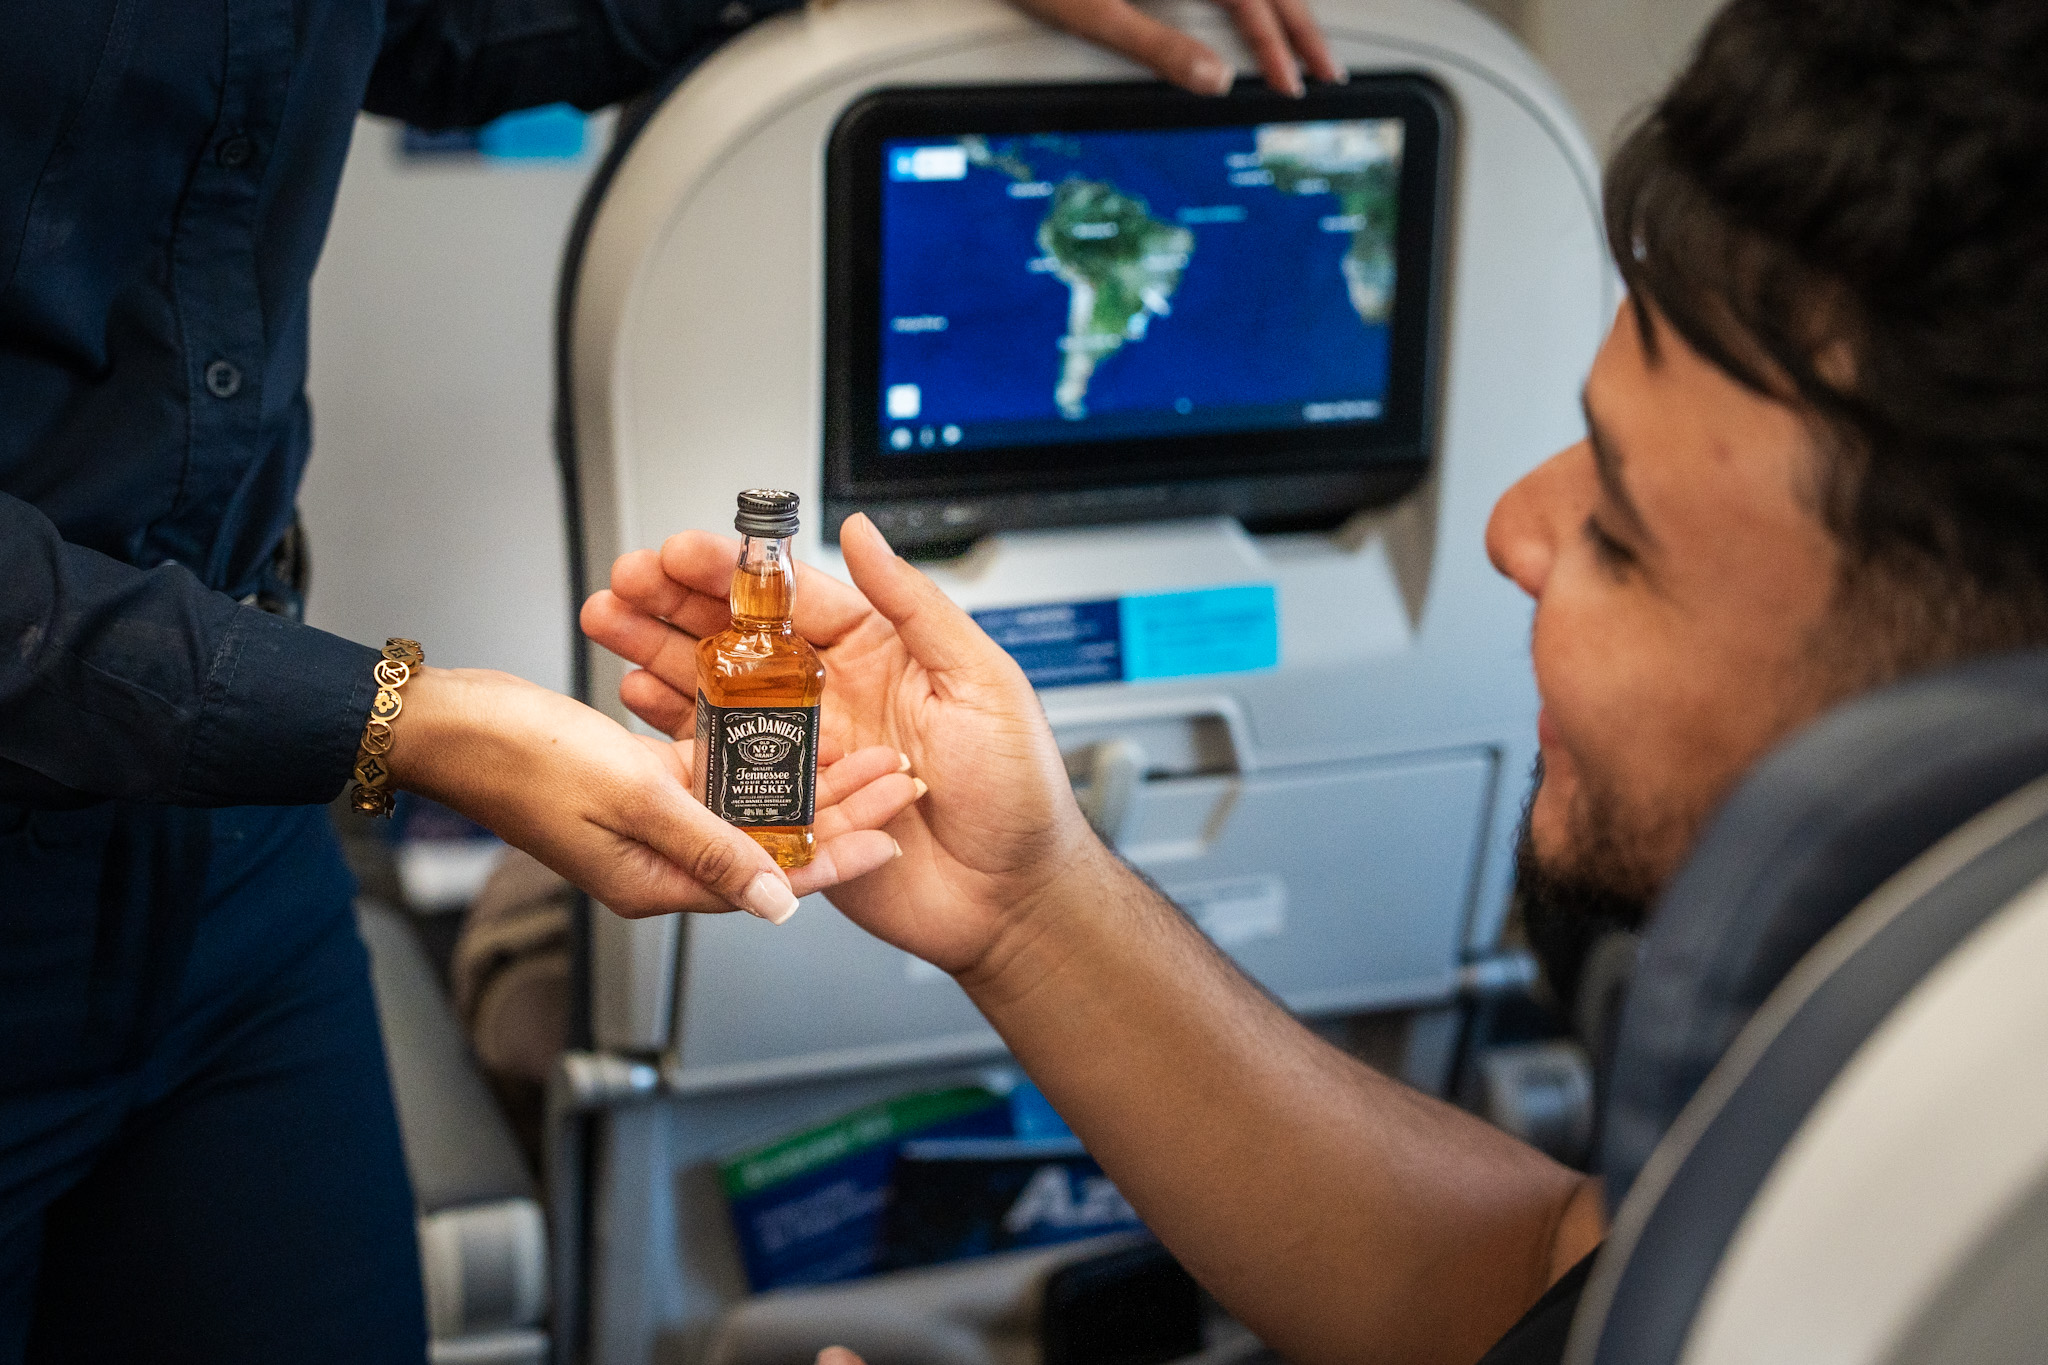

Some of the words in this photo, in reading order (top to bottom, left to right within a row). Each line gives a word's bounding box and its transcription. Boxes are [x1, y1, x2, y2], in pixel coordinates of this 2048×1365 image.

[726, 720, 758, 744] JACK
[757, 716, 806, 743] DANIEL'S
[736, 767, 790, 780] Tennessee
[731, 784, 794, 794] WHISKEY
